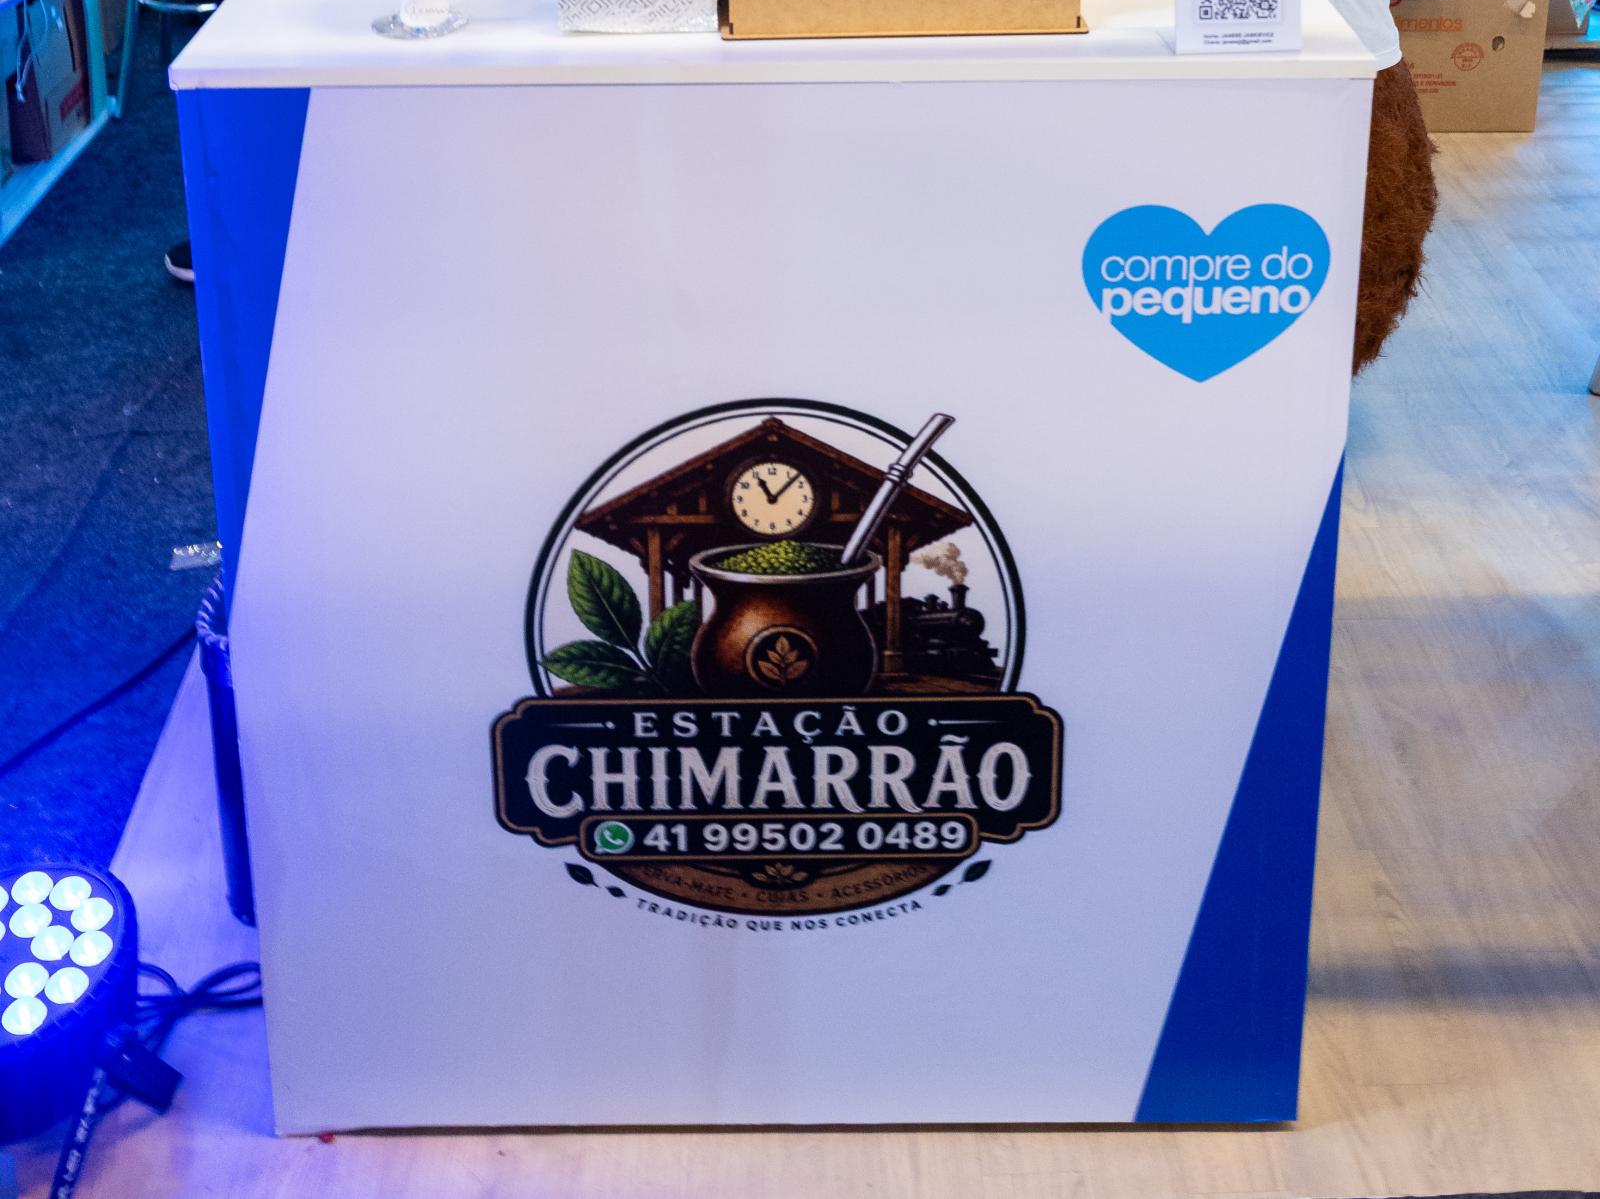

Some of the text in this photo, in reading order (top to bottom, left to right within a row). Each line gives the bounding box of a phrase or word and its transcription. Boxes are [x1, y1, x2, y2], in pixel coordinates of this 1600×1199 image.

[1101, 245, 1313, 291] compre do
[1101, 284, 1312, 324] pequeno
[633, 705, 909, 744] ESTAÇÃO
[525, 734, 1032, 819] CHIMARRÃO
[643, 820, 968, 852] 41 99502 0489
[637, 897, 923, 933] TRADIÇÃO QUE NOS CONECTA
